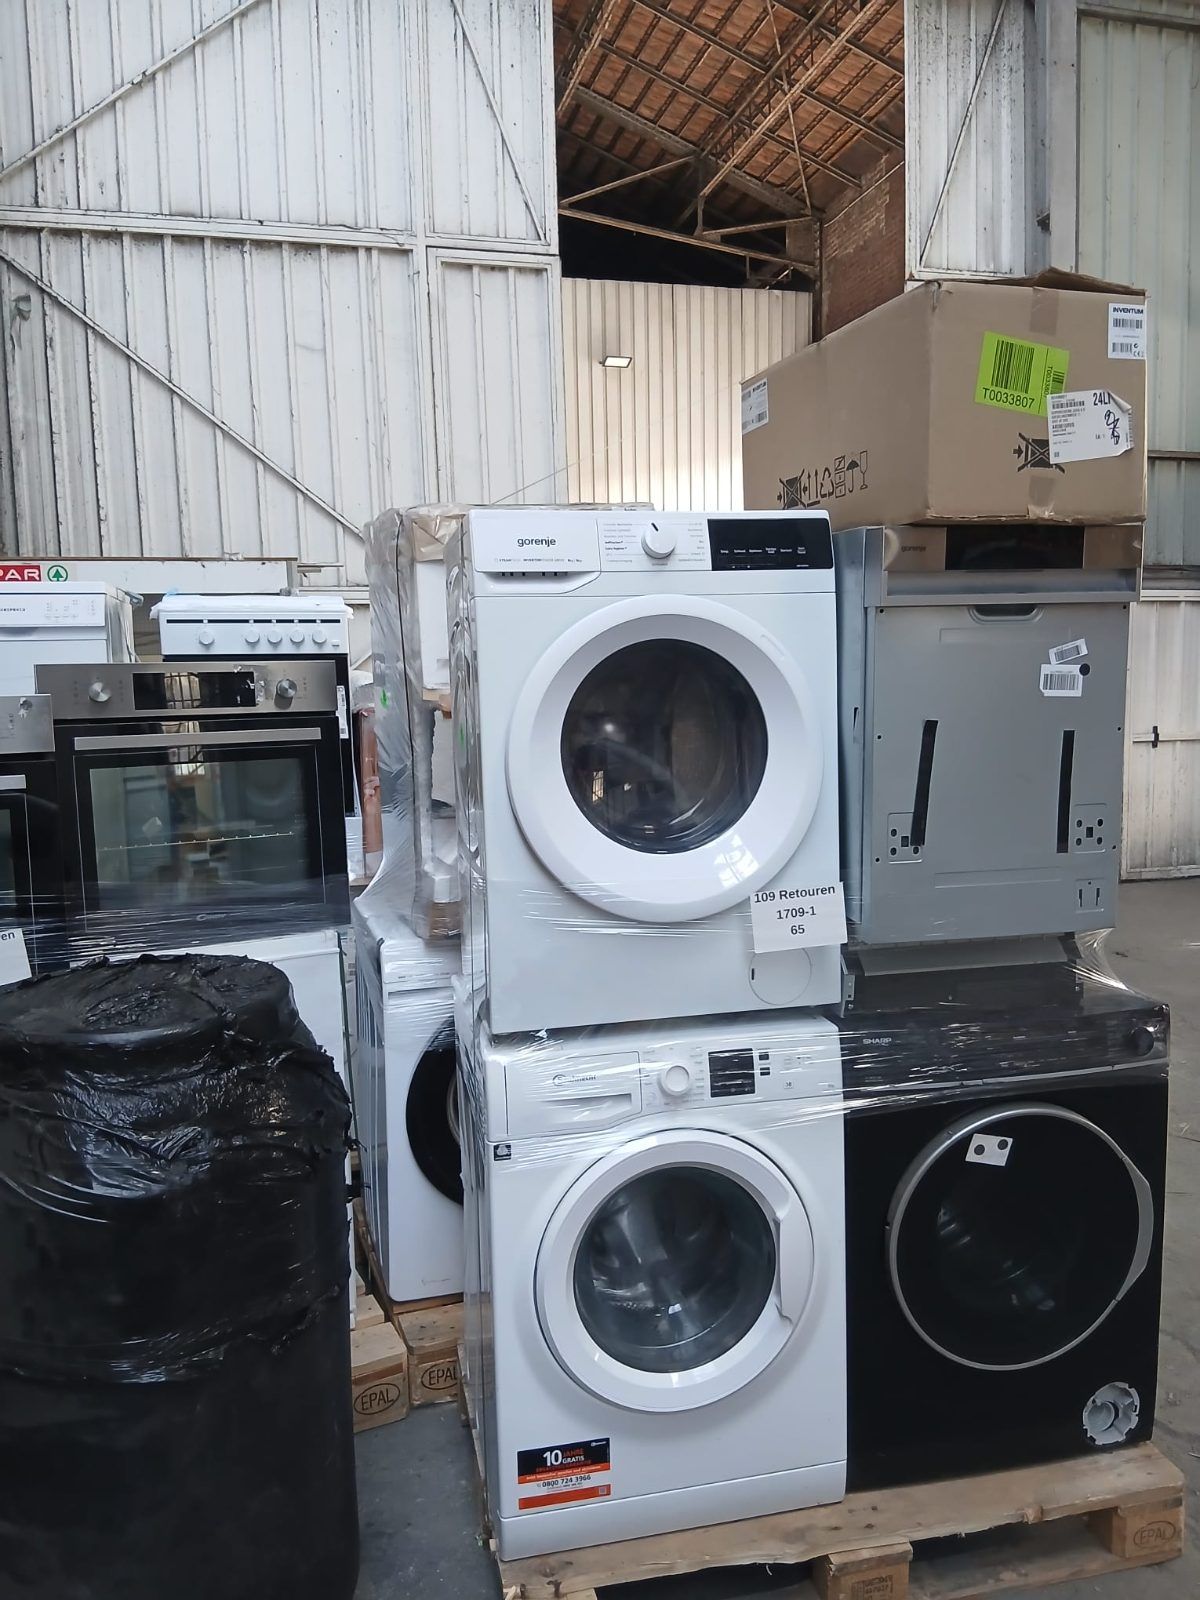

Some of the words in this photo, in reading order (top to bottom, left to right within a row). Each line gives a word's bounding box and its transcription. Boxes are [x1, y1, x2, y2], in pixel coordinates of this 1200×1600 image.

[982, 387, 1035, 409] T0033807
[517, 536, 557, 548] gorenje
[0, 569, 40, 581] AR
[754, 891, 776, 903] 109
[779, 886, 836, 900] Retouren
[776, 906, 816, 920] 1709-1
[790, 924, 805, 935] 65
[361, 1388, 394, 1411] EPAL
[543, 1450, 562, 1466] 10
[562, 1455, 585, 1464] GRATIS
[542, 1479, 559, 1488] 0800
[561, 1476, 573, 1485] 724
[575, 1474, 591, 1483] 3966
